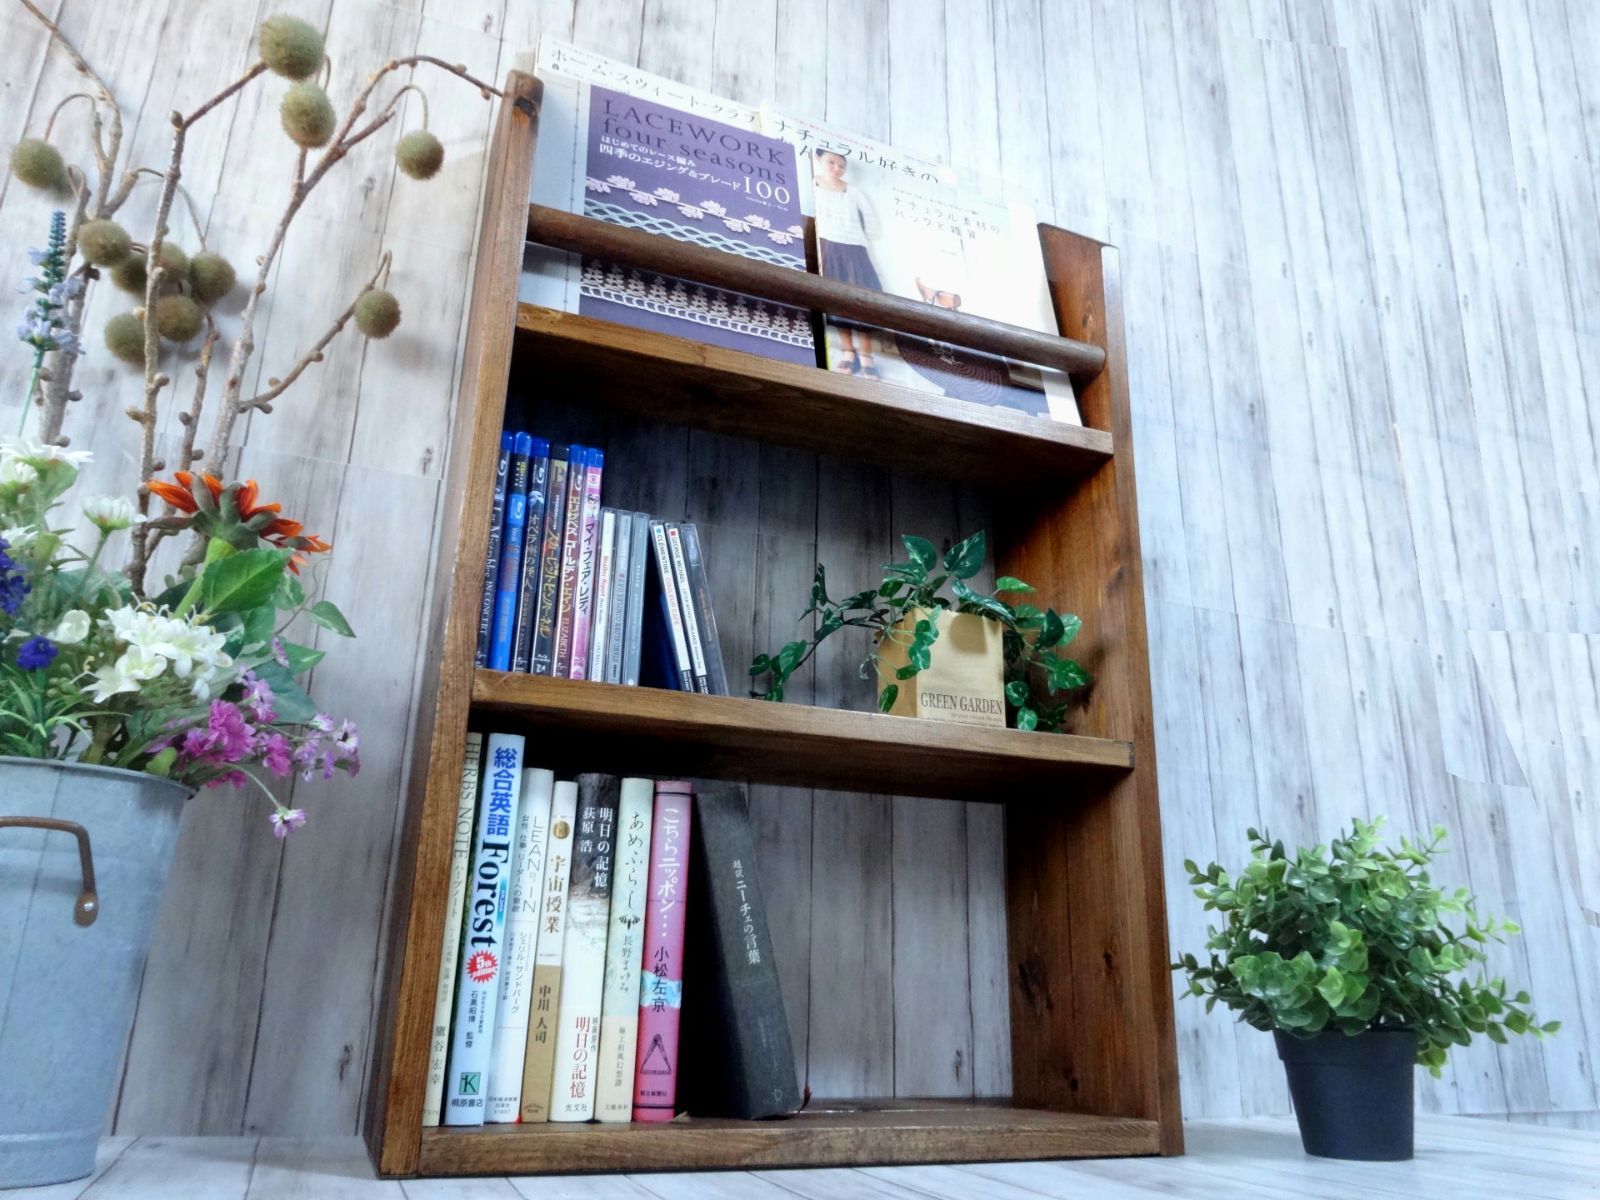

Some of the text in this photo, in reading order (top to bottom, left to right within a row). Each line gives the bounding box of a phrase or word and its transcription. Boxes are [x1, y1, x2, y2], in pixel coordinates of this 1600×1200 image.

[601, 135, 696, 166] はじめてのレース編み
[603, 99, 784, 166] LACEWORK
[604, 116, 666, 148] four
[680, 144, 786, 185] seasons
[744, 176, 790, 204] 100
[480, 590, 492, 635] CONCERT
[560, 617, 570, 658] ELIZABETH
[921, 692, 1003, 715] GREEN GARDEN
[454, 742, 480, 859] HERBS NOTE
[486, 747, 518, 837] 総合英語
[528, 816, 543, 871] LEAN
[580, 807, 596, 853] 荻原浩
[594, 807, 613, 888] 明日の記憶
[624, 811, 644, 909] あめふらし
[470, 838, 510, 948] Forest
[544, 855, 566, 934] 宇宙授業
[736, 880, 760, 965] ニーチェの言葉
[476, 954, 492, 969] 5th
[652, 946, 669, 1013] 小松左京
[535, 984, 551, 1044] 中川人司
[570, 1016, 590, 1098] 明日の記憶
[565, 1103, 588, 1112] 光文社
